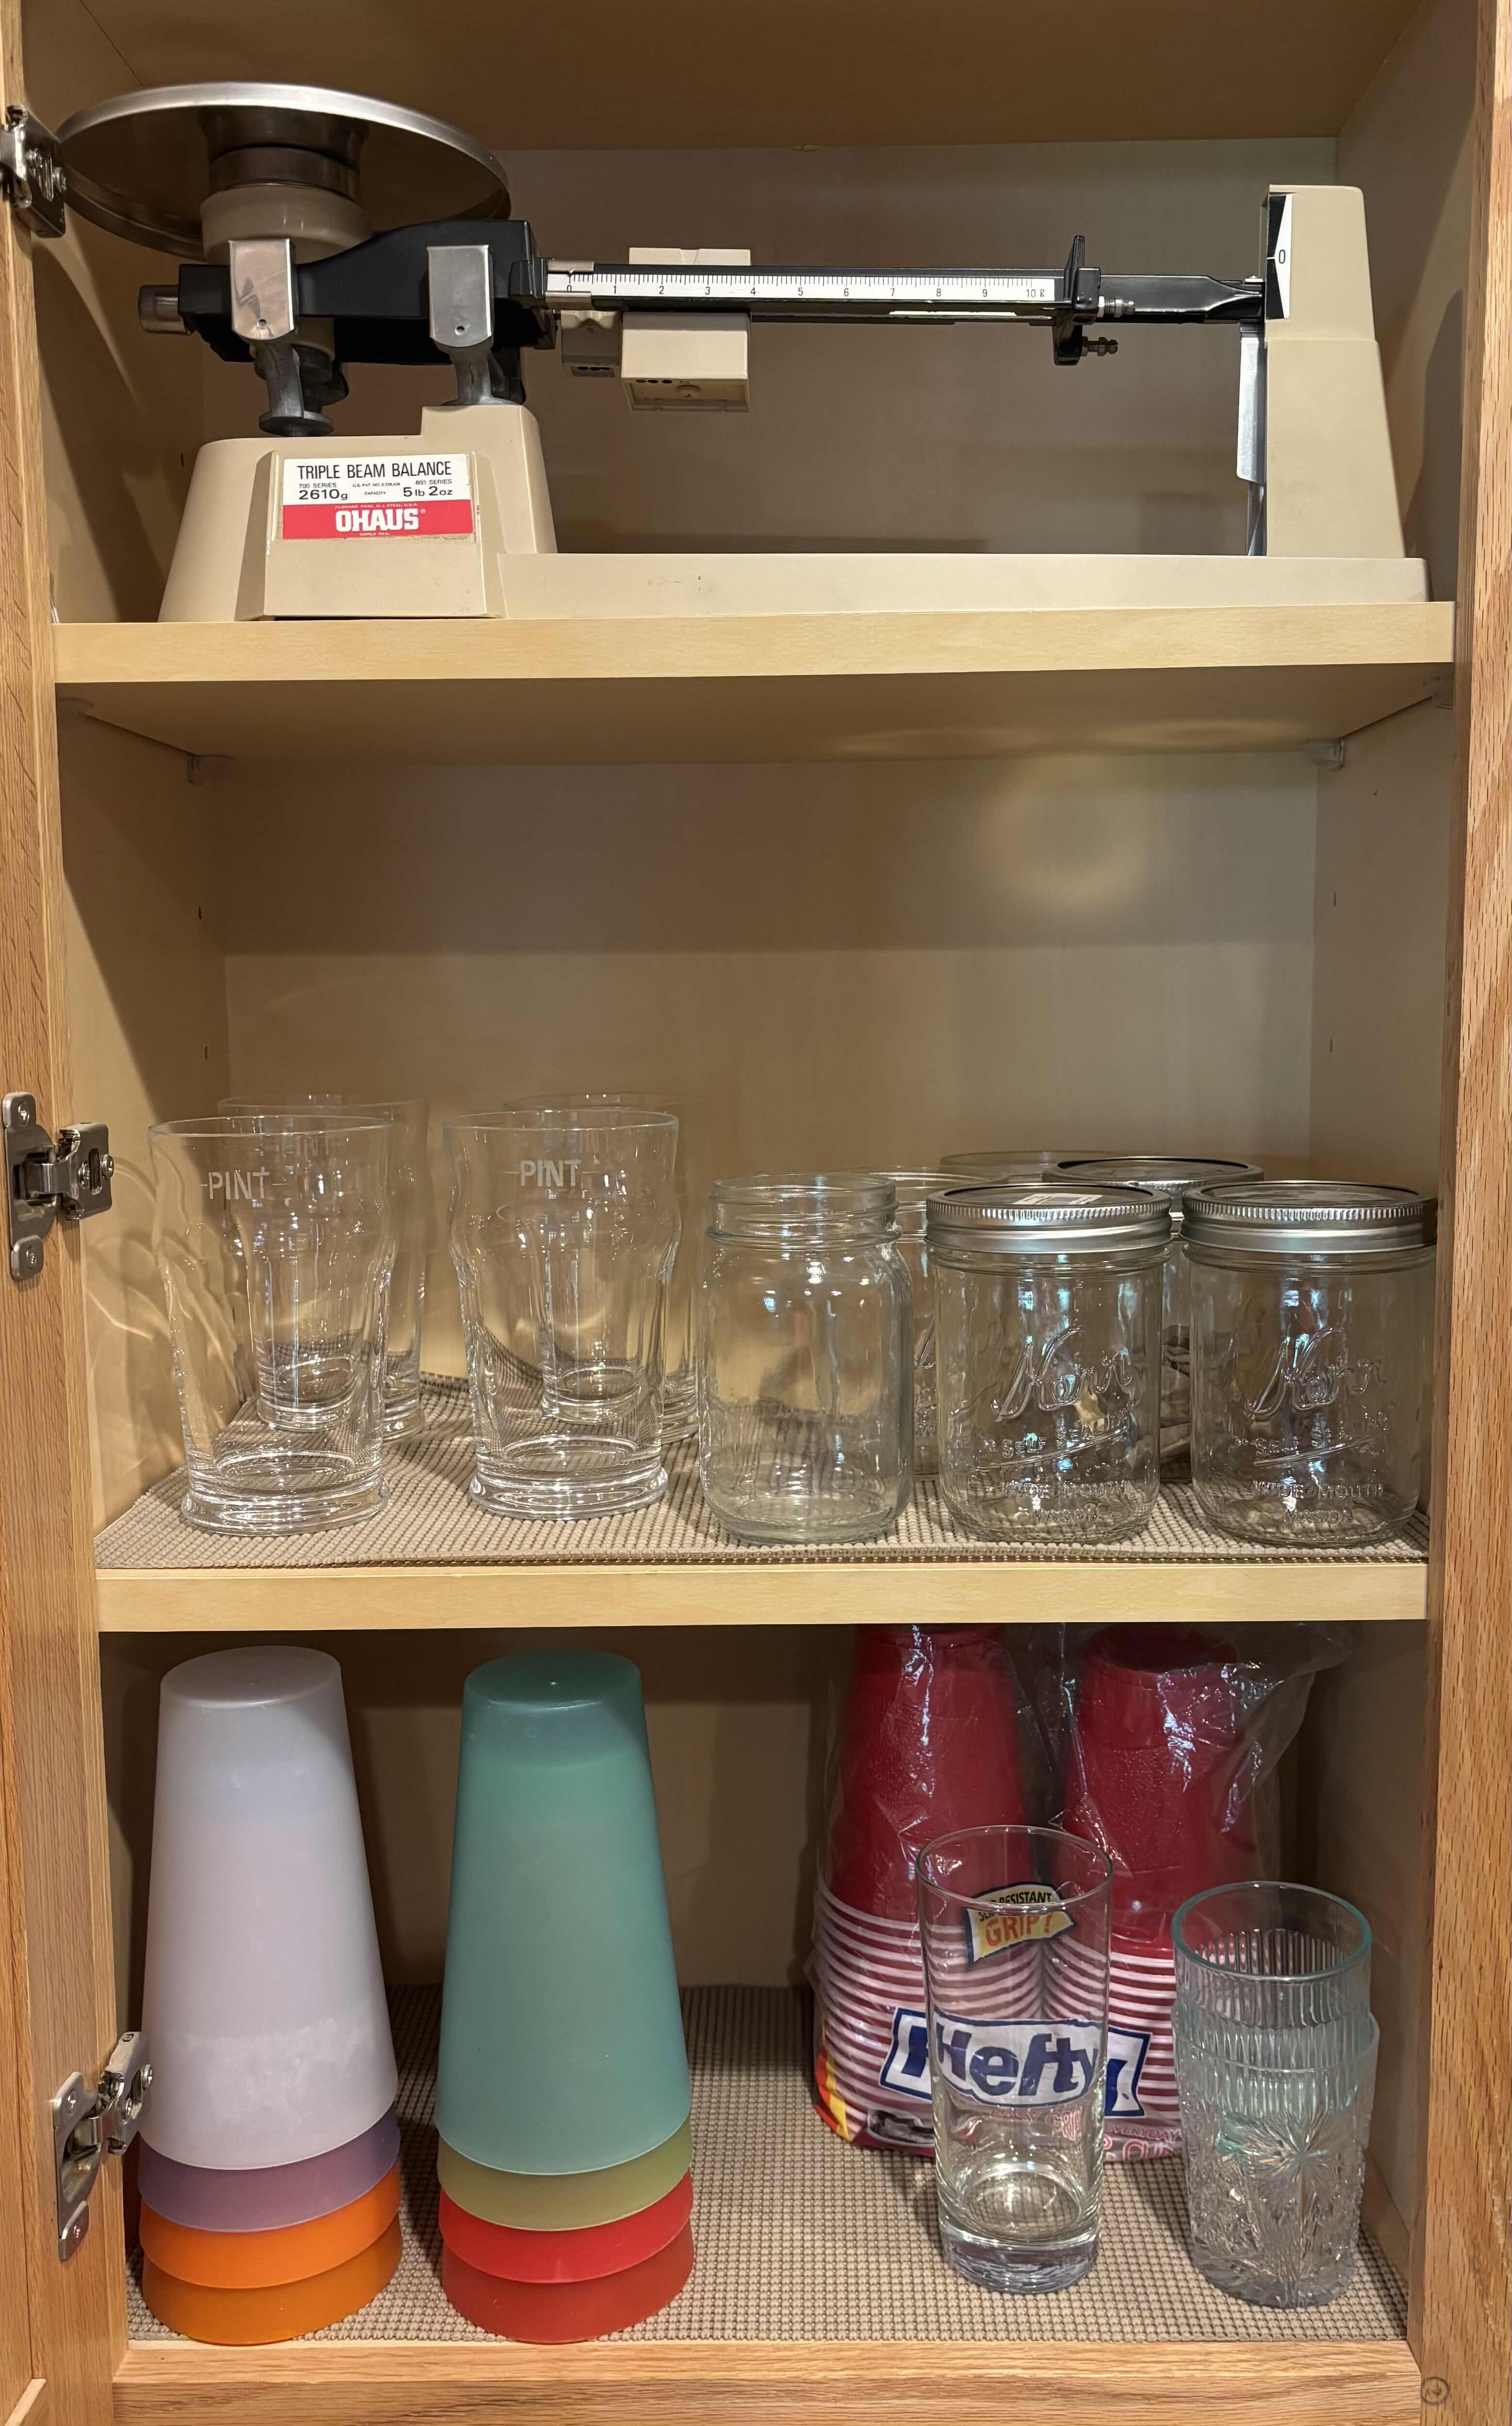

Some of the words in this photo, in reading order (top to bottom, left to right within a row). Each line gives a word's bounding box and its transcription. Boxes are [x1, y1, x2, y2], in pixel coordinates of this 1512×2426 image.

[1278, 249, 1286, 264] 0
[613, 285, 617, 294] 1
[658, 286, 664, 295] 2
[705, 286, 711, 295] 3
[750, 286, 756, 295] 4
[798, 287, 803, 296] 5
[844, 288, 849, 297] 6
[890, 288, 895, 297] 7
[936, 288, 941, 297] 8
[982, 289, 987, 297] 9
[1026, 289, 1036, 298] 10
[297, 465, 340, 479] TRIPLE
[347, 463, 386, 478] BEAM
[391, 461, 452, 477] BALANCE
[336, 508, 419, 532] OHAUS
[208, 1170, 270, 1200] PINT
[520, 1159, 582, 1187] PINT
[935, 2022, 1099, 2097] Hefty
